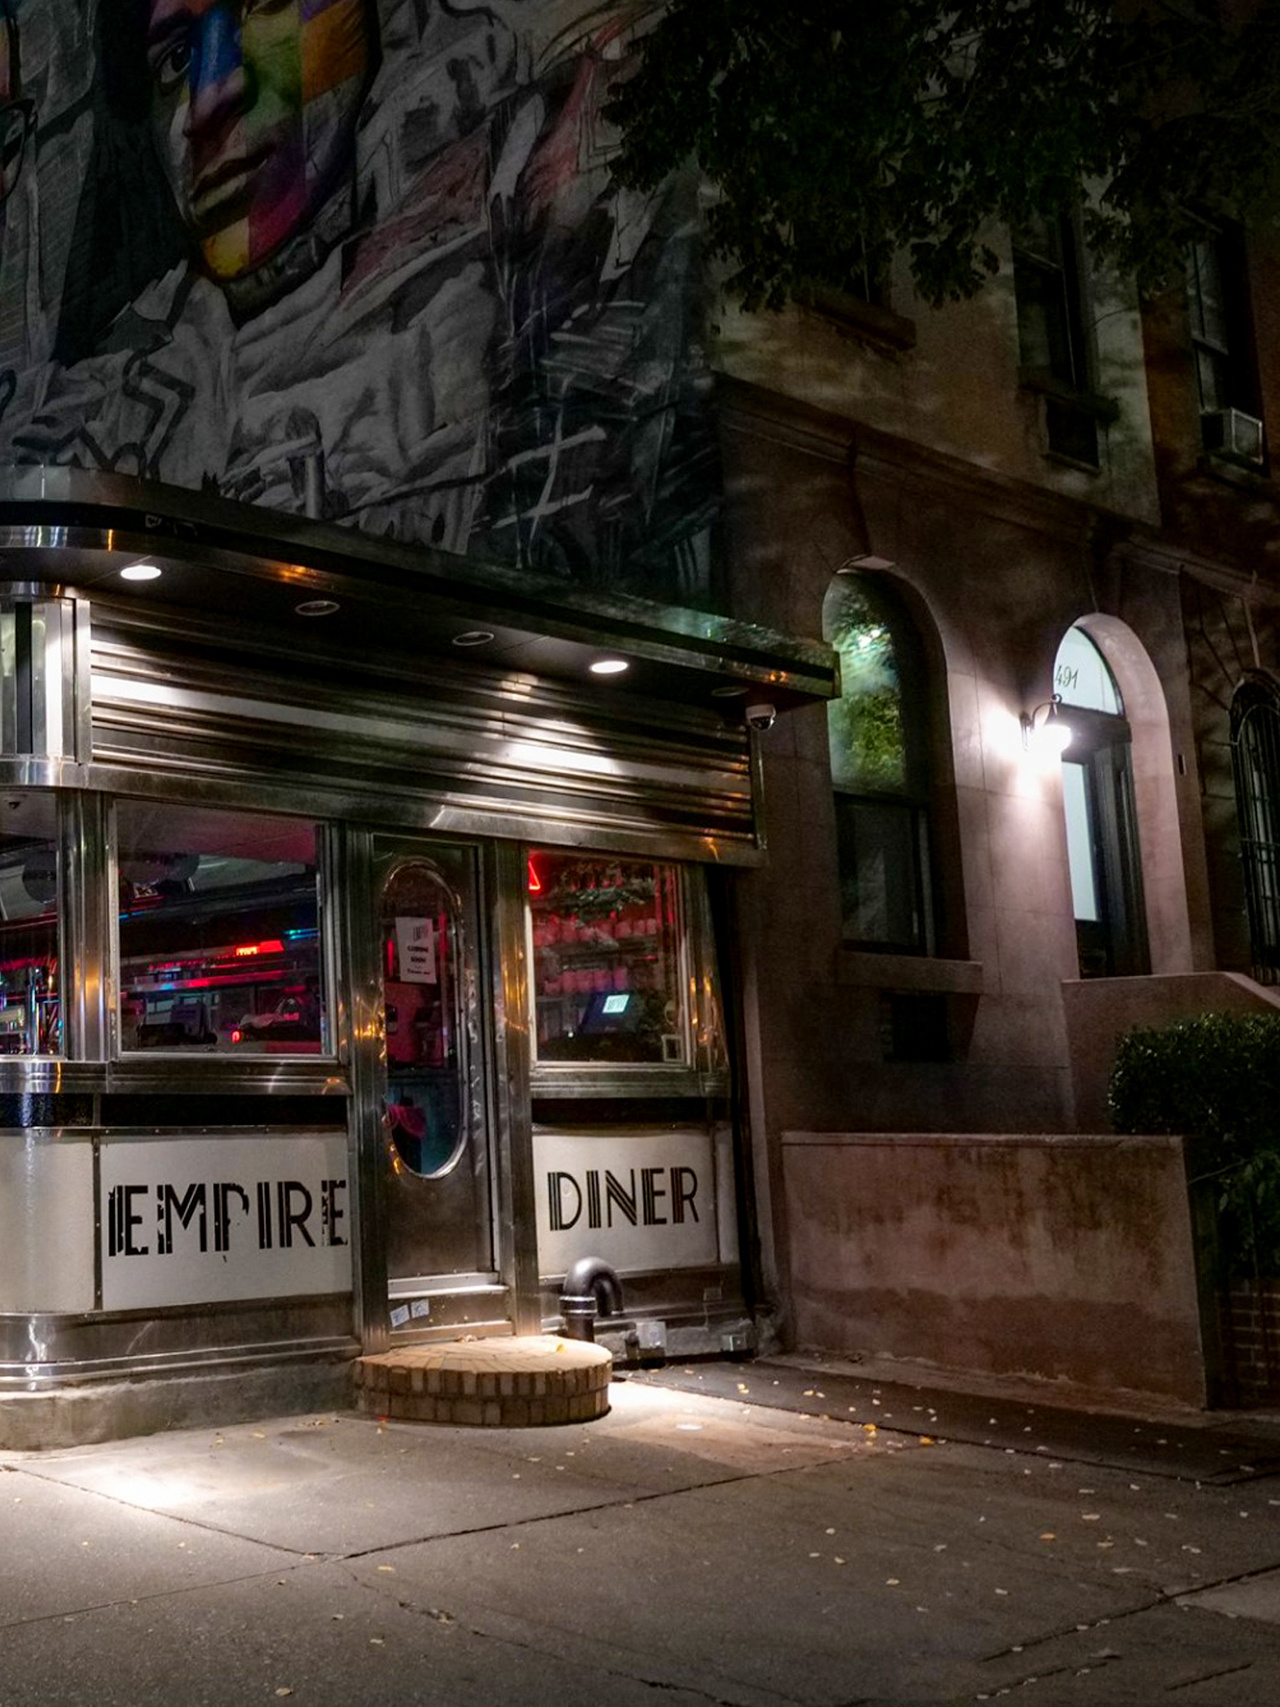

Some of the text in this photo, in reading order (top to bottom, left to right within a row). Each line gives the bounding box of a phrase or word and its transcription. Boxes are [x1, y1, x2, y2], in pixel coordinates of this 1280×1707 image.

[1055, 665, 1079, 690] 491
[108, 1166, 699, 1257] EMPIRE DINER
